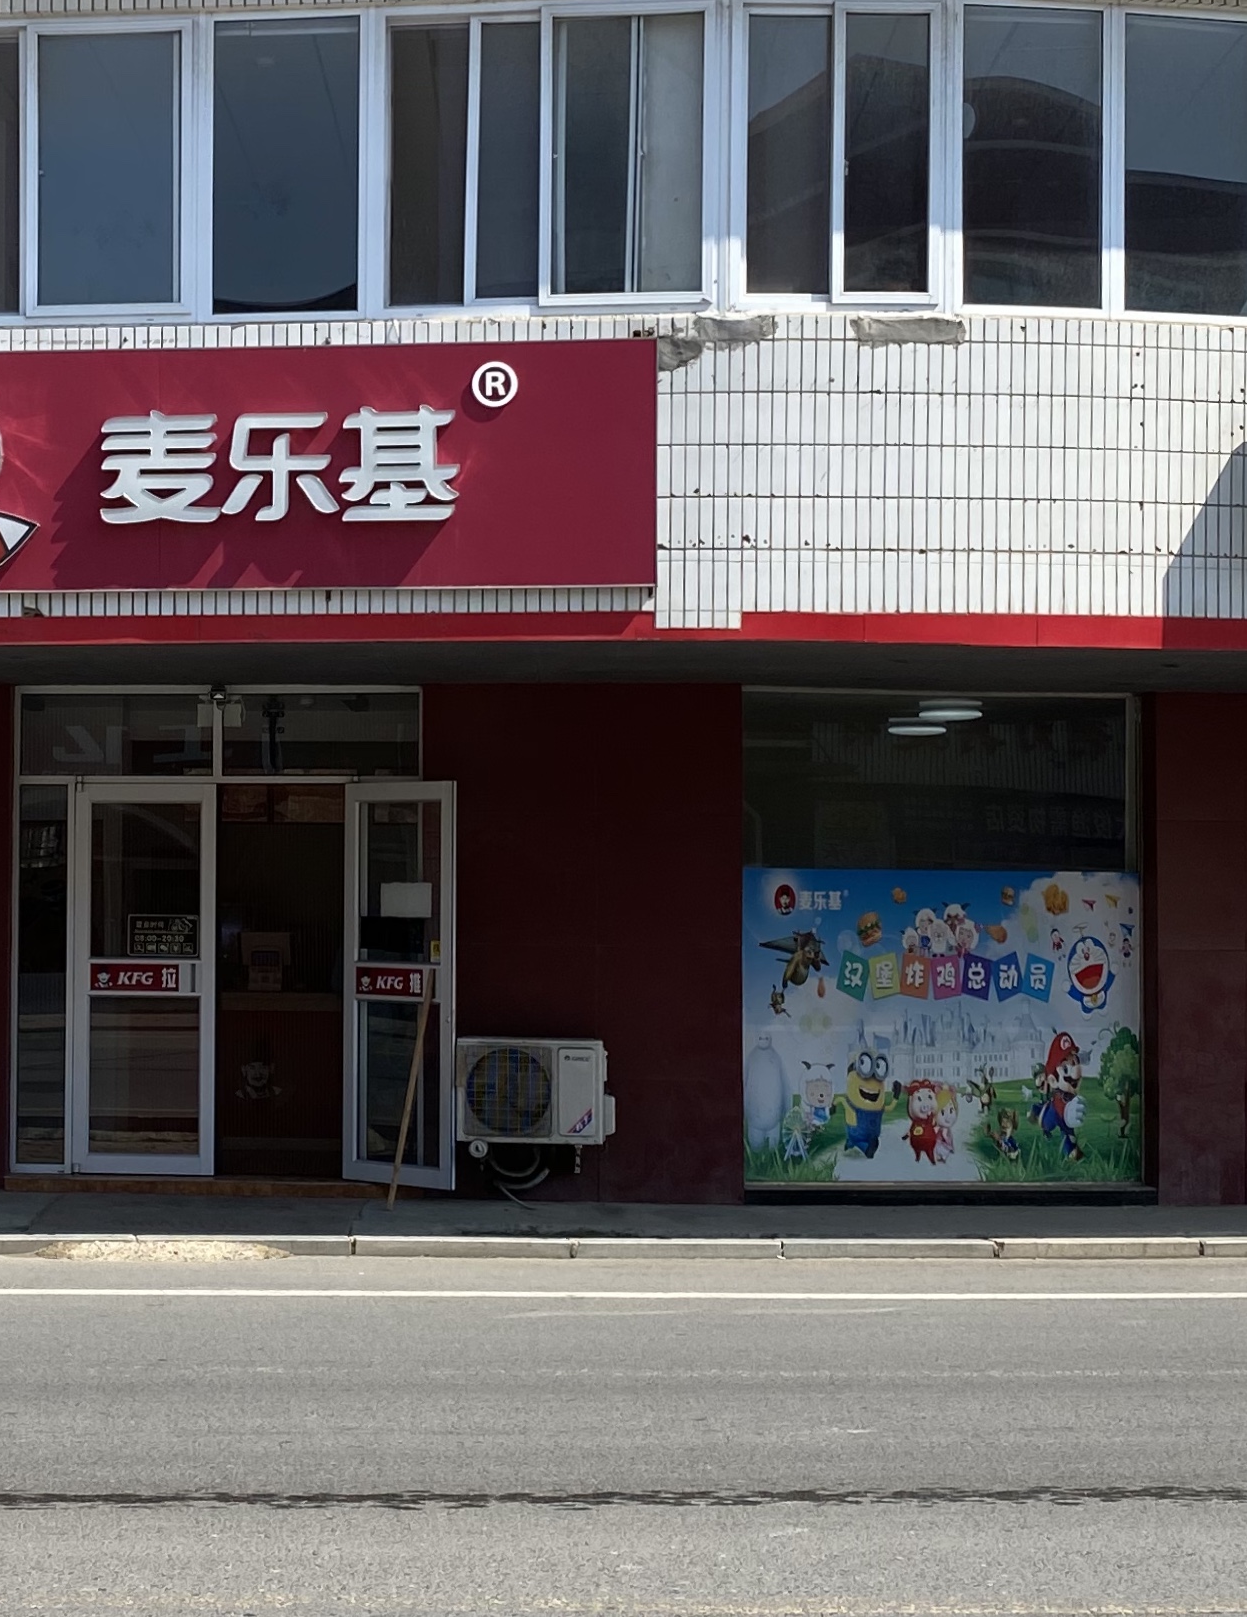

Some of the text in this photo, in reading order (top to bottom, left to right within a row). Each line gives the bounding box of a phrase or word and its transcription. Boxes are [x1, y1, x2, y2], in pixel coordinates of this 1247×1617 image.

[100, 404, 462, 525] 麦乐基
[798, 889, 843, 911] 麦乐基
[117, 972, 154, 985] KFG
[161, 967, 177, 988] 拉
[375, 975, 404, 990] KFG
[409, 972, 422, 994] 推
[842, 961, 1047, 990] 汉堡炸鸡总动员
